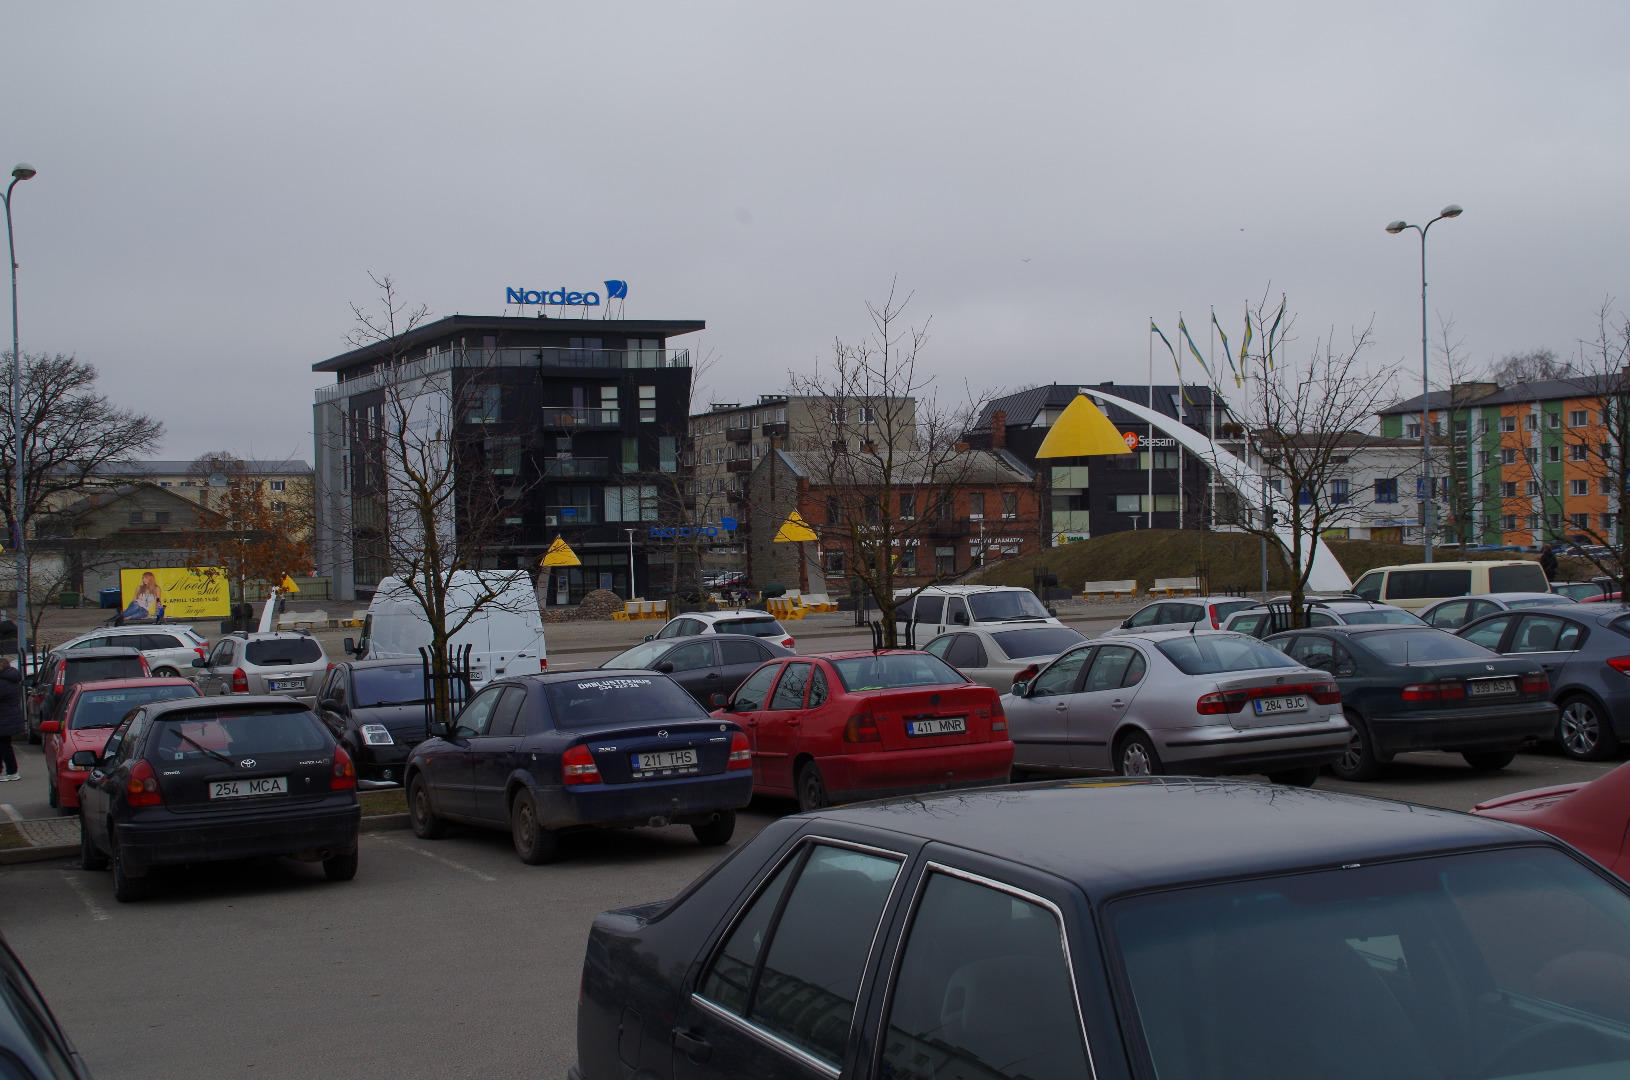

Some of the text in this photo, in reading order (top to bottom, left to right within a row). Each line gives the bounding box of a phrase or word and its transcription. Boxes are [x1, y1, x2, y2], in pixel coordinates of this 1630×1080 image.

[506, 286, 600, 306] Nordea
[1138, 435, 1176, 447] Seesam
[164, 577, 206, 592] Mood
[1474, 681, 1513, 693] 339 ASA
[1265, 698, 1305, 711] 284 BJC
[917, 719, 962, 733] 411 MNR
[644, 751, 692, 767] 211 THS
[215, 779, 281, 797] 254 MCA
